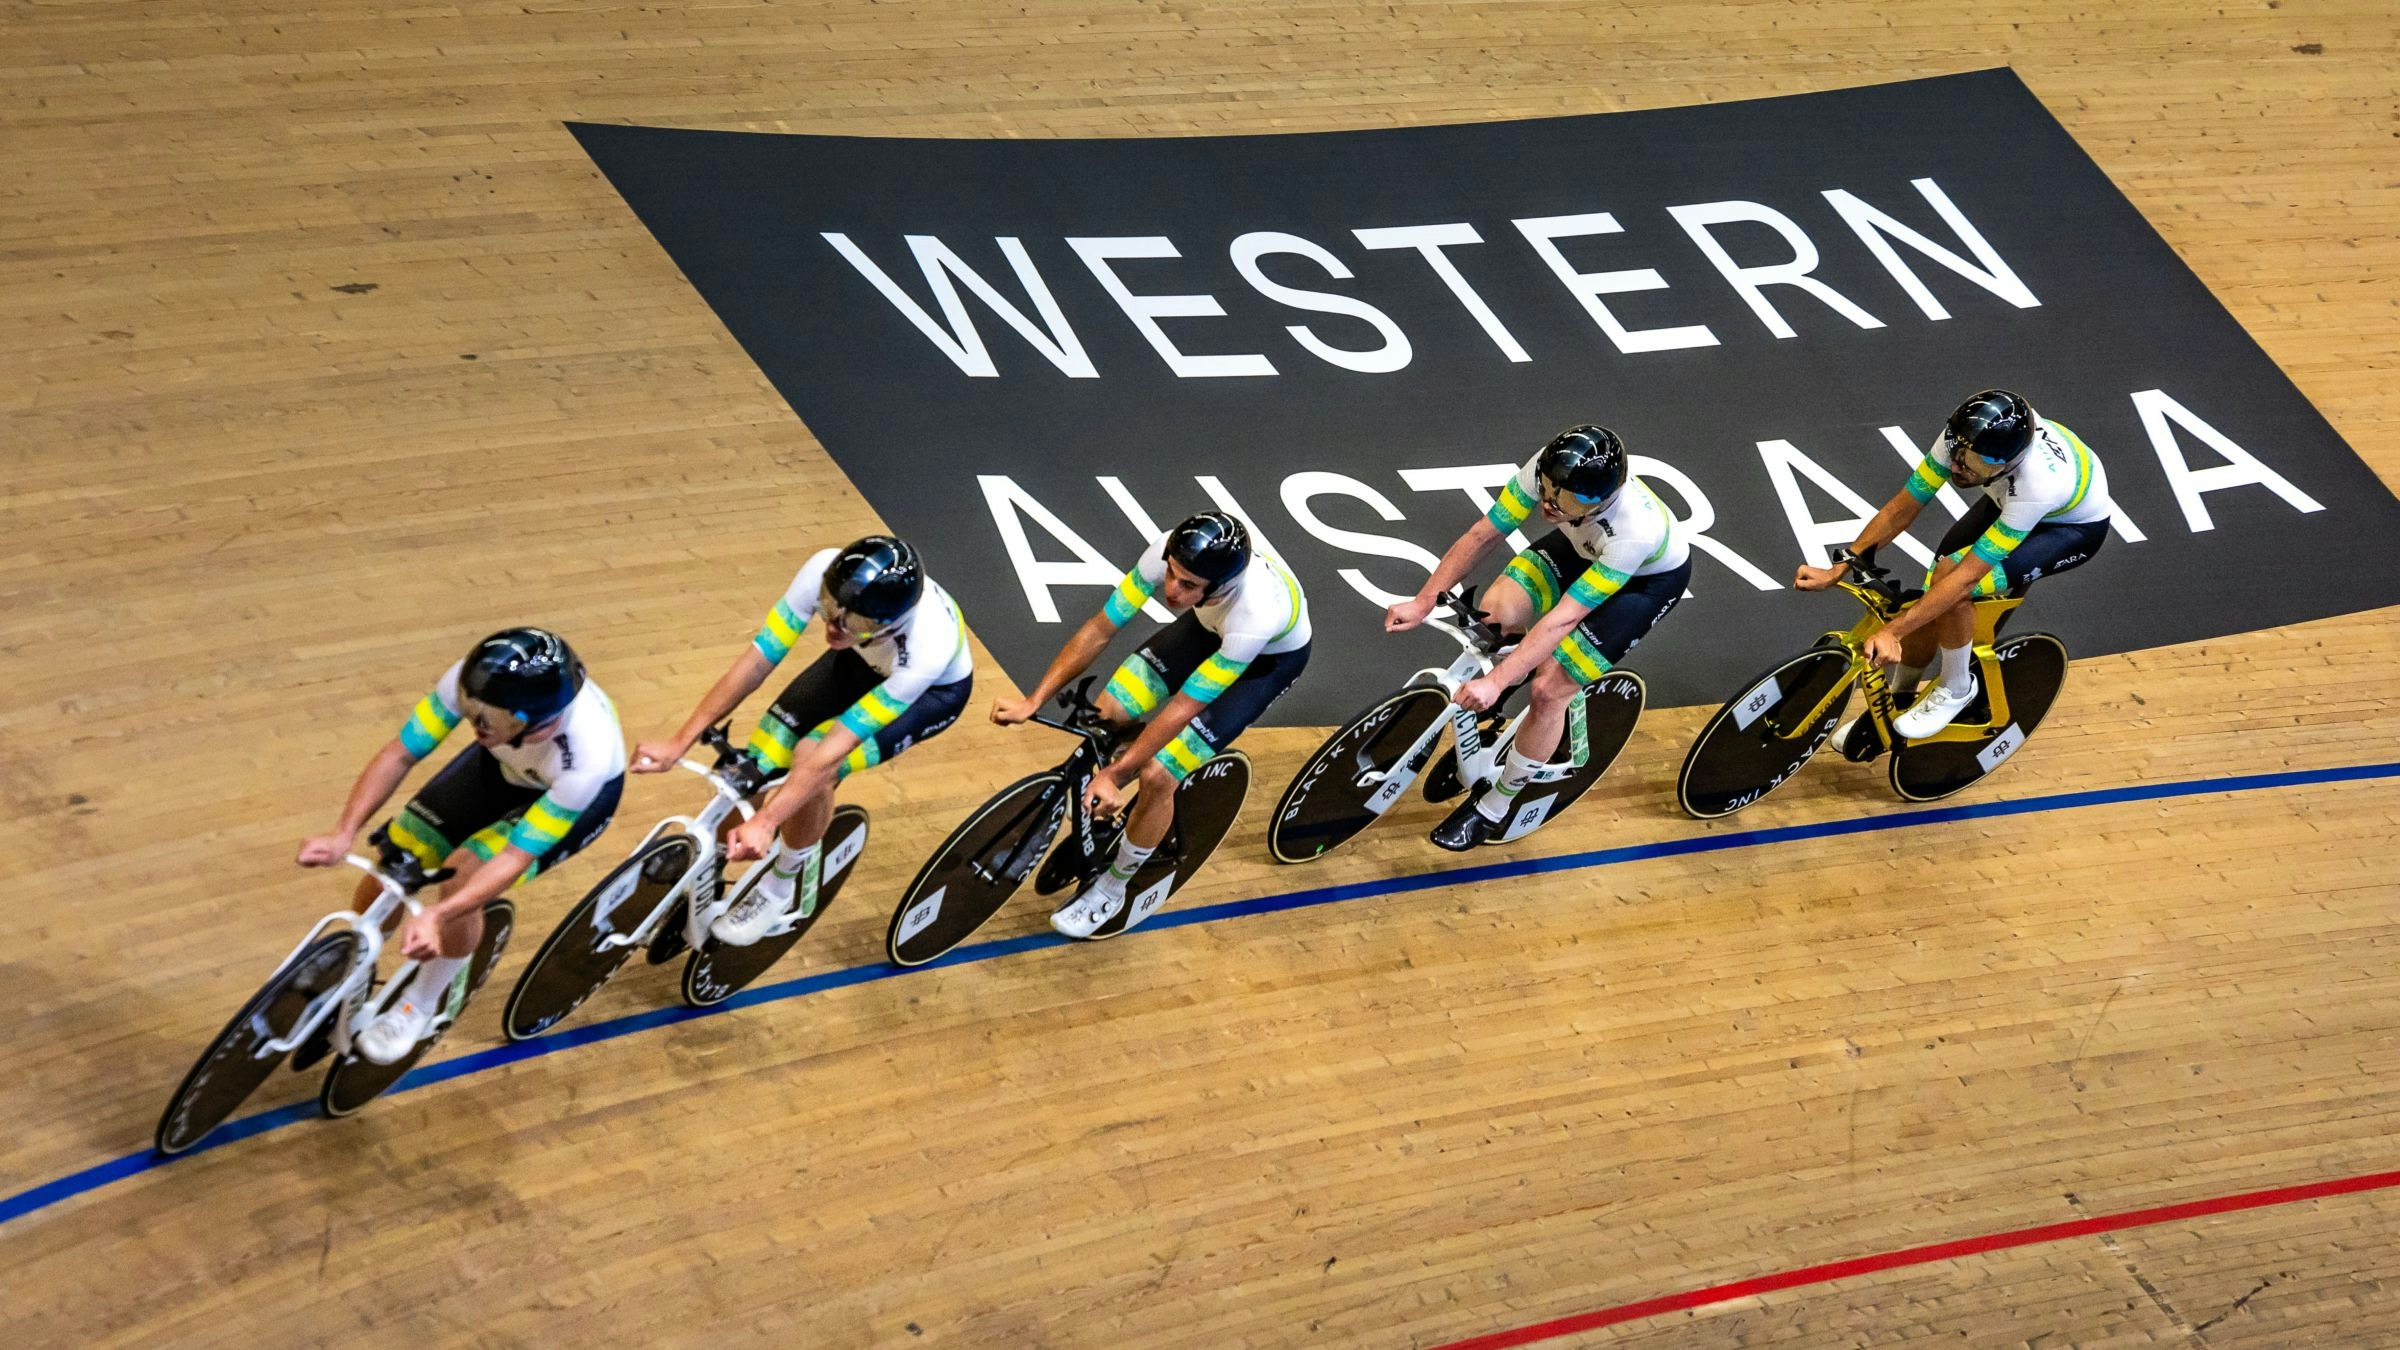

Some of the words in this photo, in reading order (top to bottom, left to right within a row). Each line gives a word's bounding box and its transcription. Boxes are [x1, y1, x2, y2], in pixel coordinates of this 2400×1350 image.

[820, 177, 2043, 379] WESTERN
[976, 388, 2327, 626] ASTRAA
[1536, 549, 1563, 578] Santini
[1996, 644, 2022, 662] NC
[1612, 678, 1638, 701] INC
[1863, 667, 1896, 721] ACTOR
[1190, 715, 1220, 744] Santini
[1456, 709, 1481, 762] ACTOR
[1770, 717, 1839, 789] BLACK
[1202, 761, 1234, 780] INC
[1285, 744, 1346, 822] BLACK
[1354, 706, 1393, 739] INC
[1080, 773, 1095, 857] AON18
[1723, 788, 1760, 812] INC
[695, 862, 715, 917] CTOR
